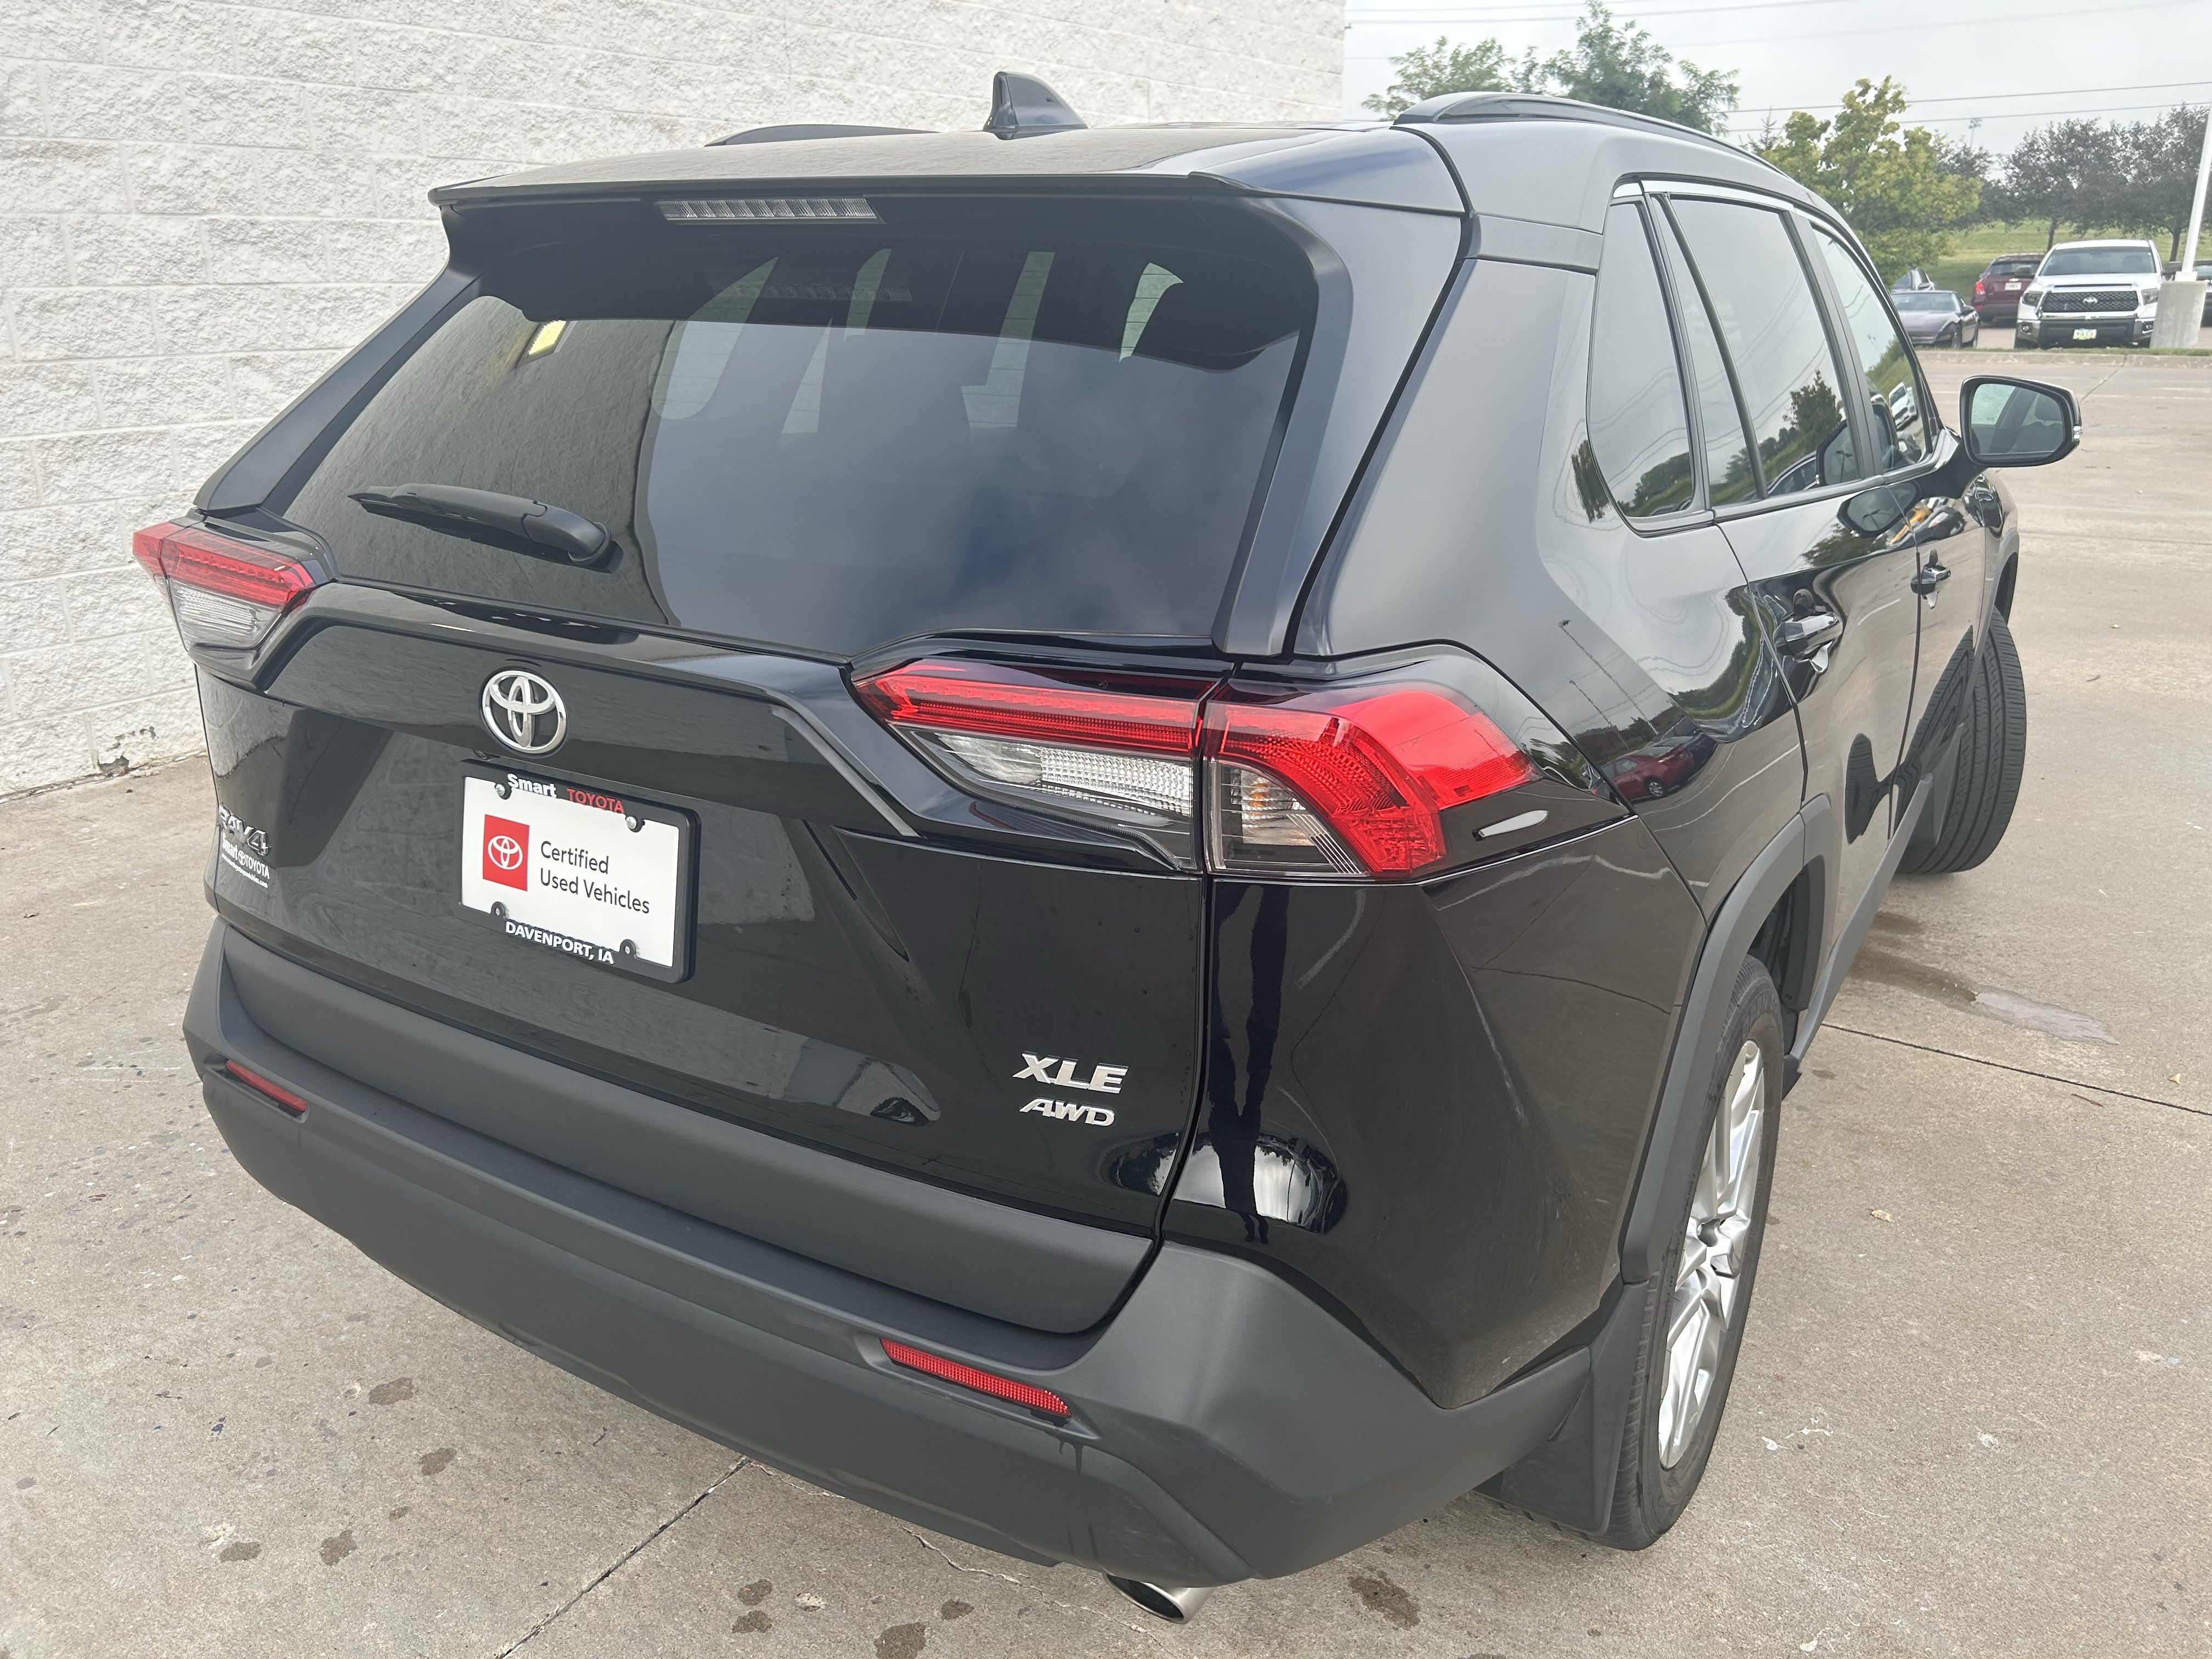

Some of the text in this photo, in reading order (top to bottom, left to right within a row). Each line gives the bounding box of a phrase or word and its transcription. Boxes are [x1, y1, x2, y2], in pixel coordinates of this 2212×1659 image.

[507, 774, 625, 814] Smart TOYOTA
[219, 804, 270, 857] RAV4
[222, 832, 238, 861] Smart
[245, 854, 270, 879] TOYOTA
[540, 840, 609, 874] Certified
[540, 868, 650, 914] Used Vehicles
[505, 921, 614, 964] DAVENPORT, IA
[1012, 1052, 1129, 1094] XLE
[1019, 1097, 1115, 1126] AWD
